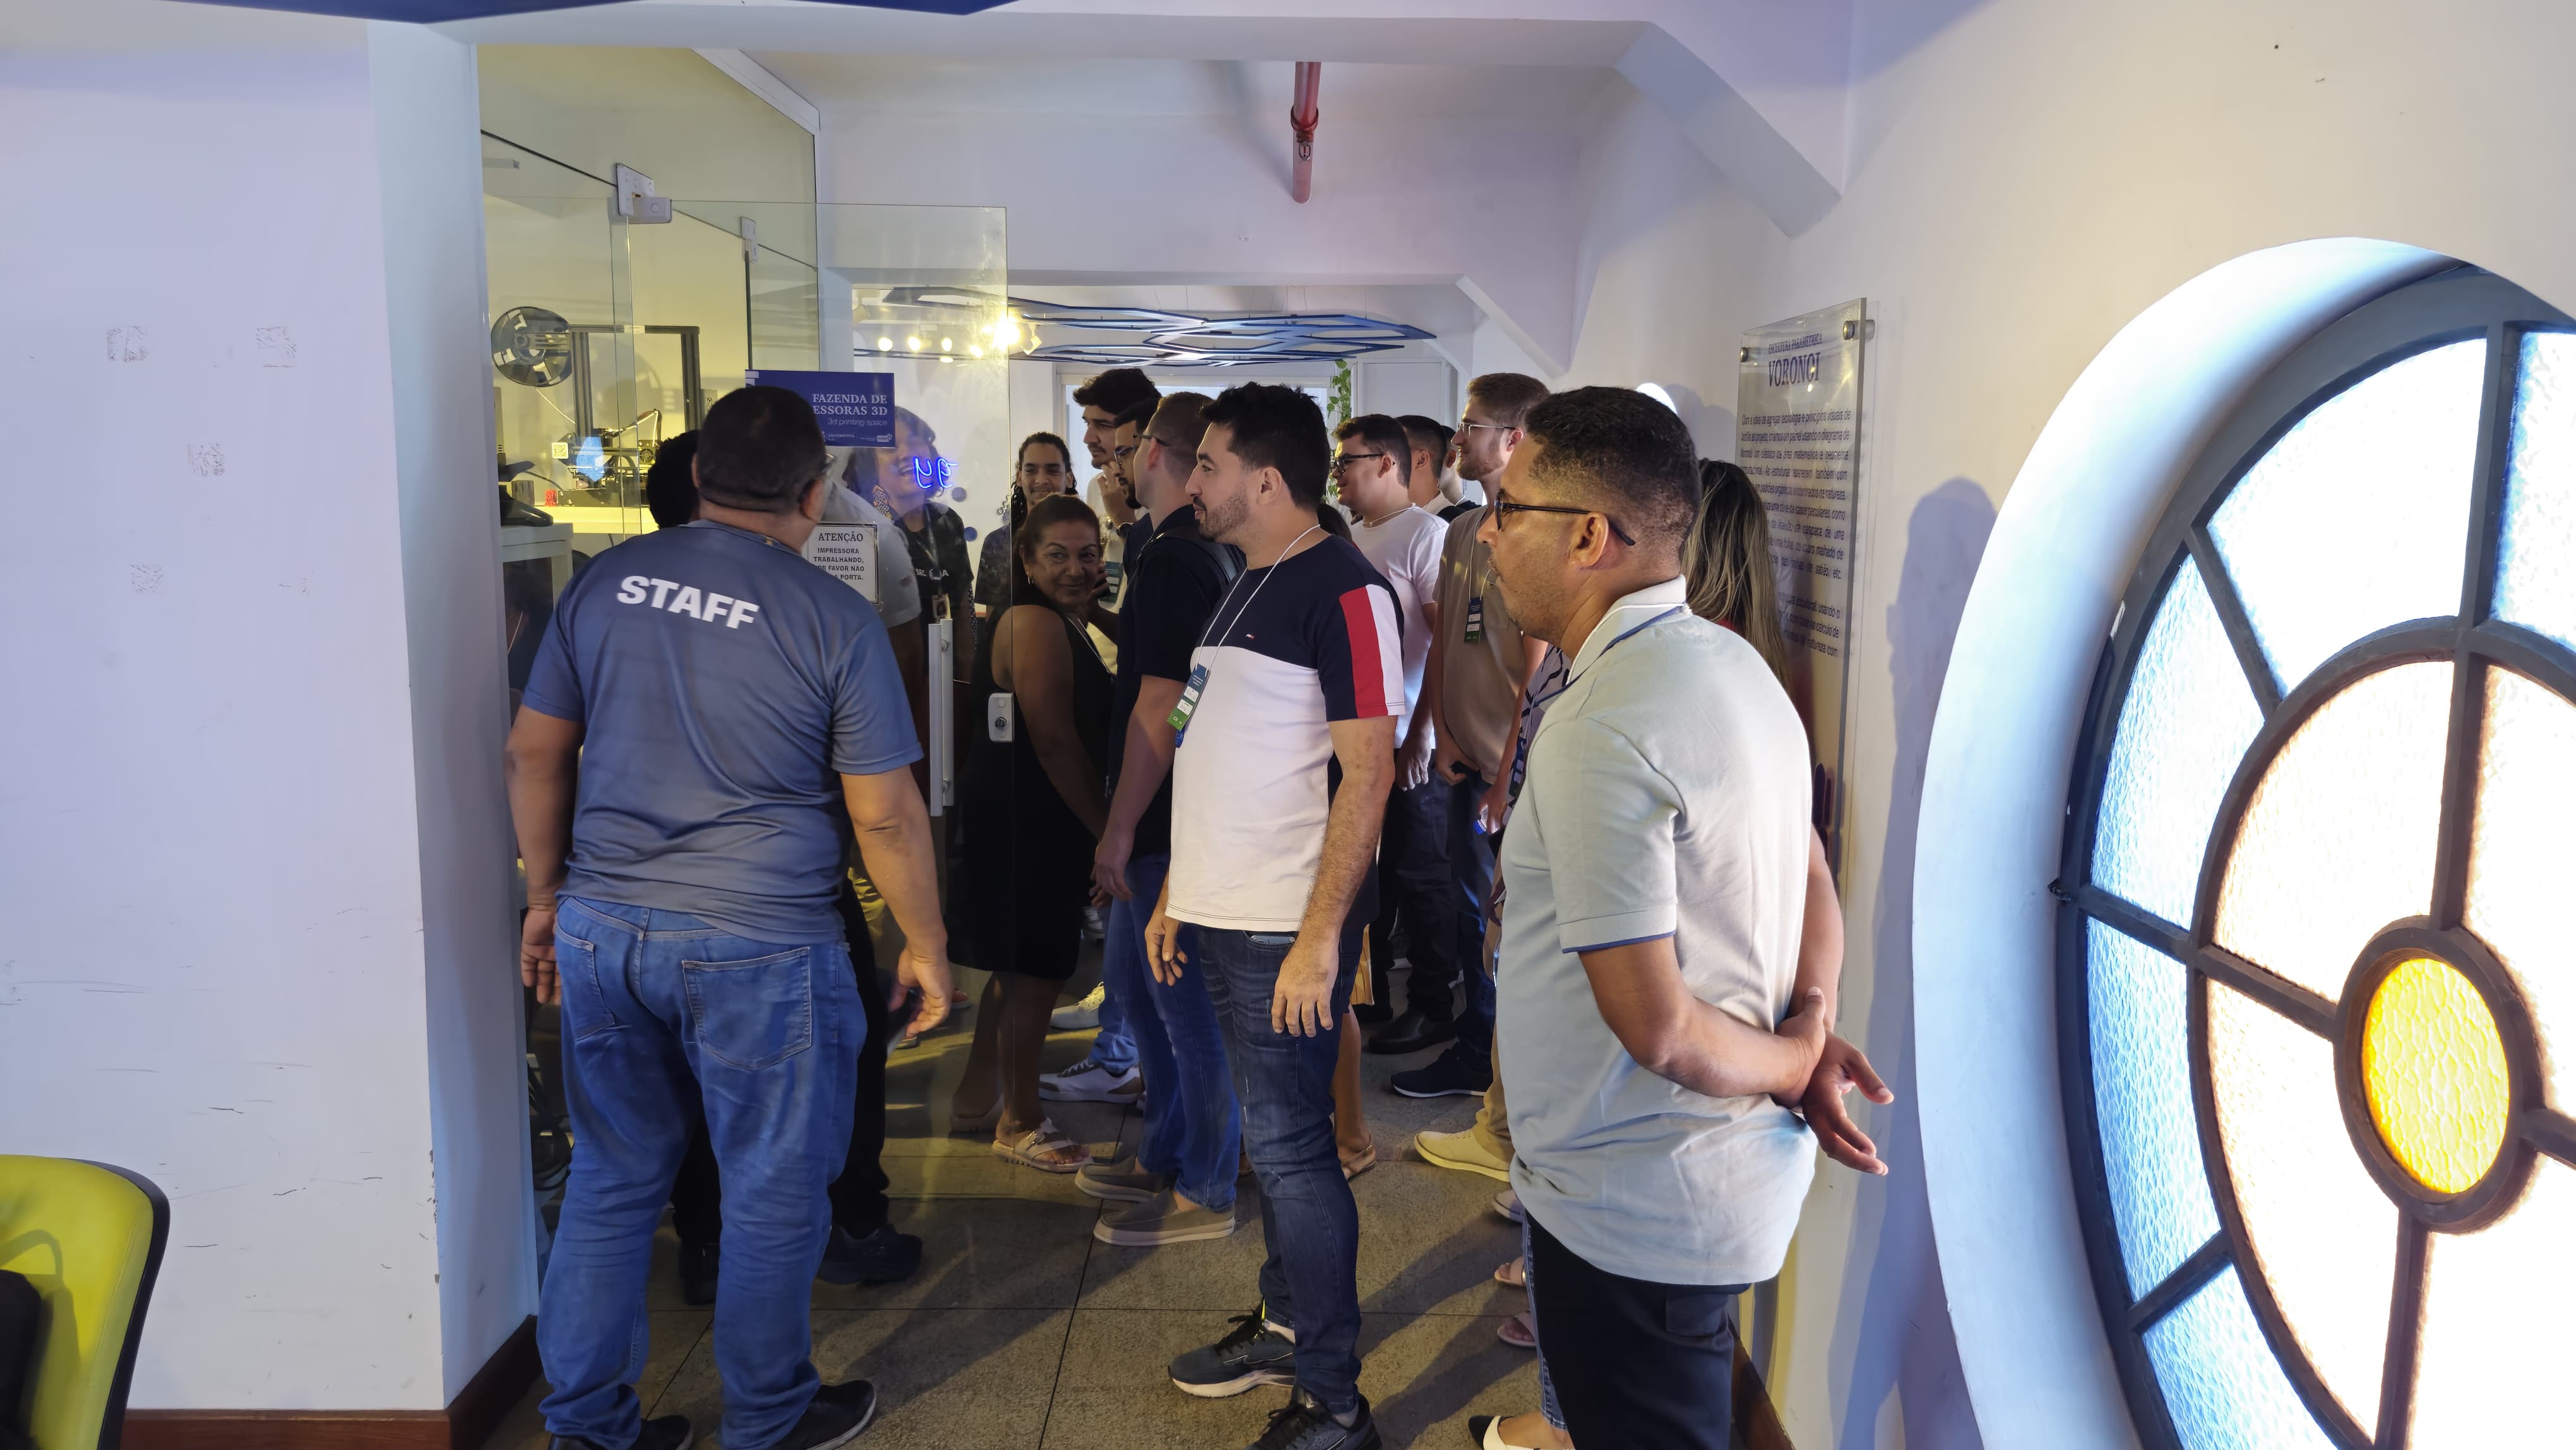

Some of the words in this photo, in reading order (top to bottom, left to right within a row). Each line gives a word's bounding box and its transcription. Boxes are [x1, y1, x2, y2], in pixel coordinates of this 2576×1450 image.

[1768, 352, 1821, 387] VORONOI
[813, 393, 868, 404] FAZENDA
[871, 395, 887, 404] DE
[813, 405, 868, 416] ESSORAS
[872, 406, 888, 416] 3D
[1844, 407, 1851, 420] de
[838, 418, 865, 427] printing
[1843, 427, 1849, 440] de
[1837, 470, 1847, 481] com
[1832, 510, 1845, 520] como
[818, 531, 863, 543] ATENÇÃO
[1834, 530, 1844, 541] uma
[1837, 548, 1844, 560] de
[617, 575, 760, 629] STAFF
[1818, 604, 1835, 617] usando
[1837, 609, 1840, 619] o
[1833, 626, 1839, 638] de
[1827, 646, 1838, 657] com
